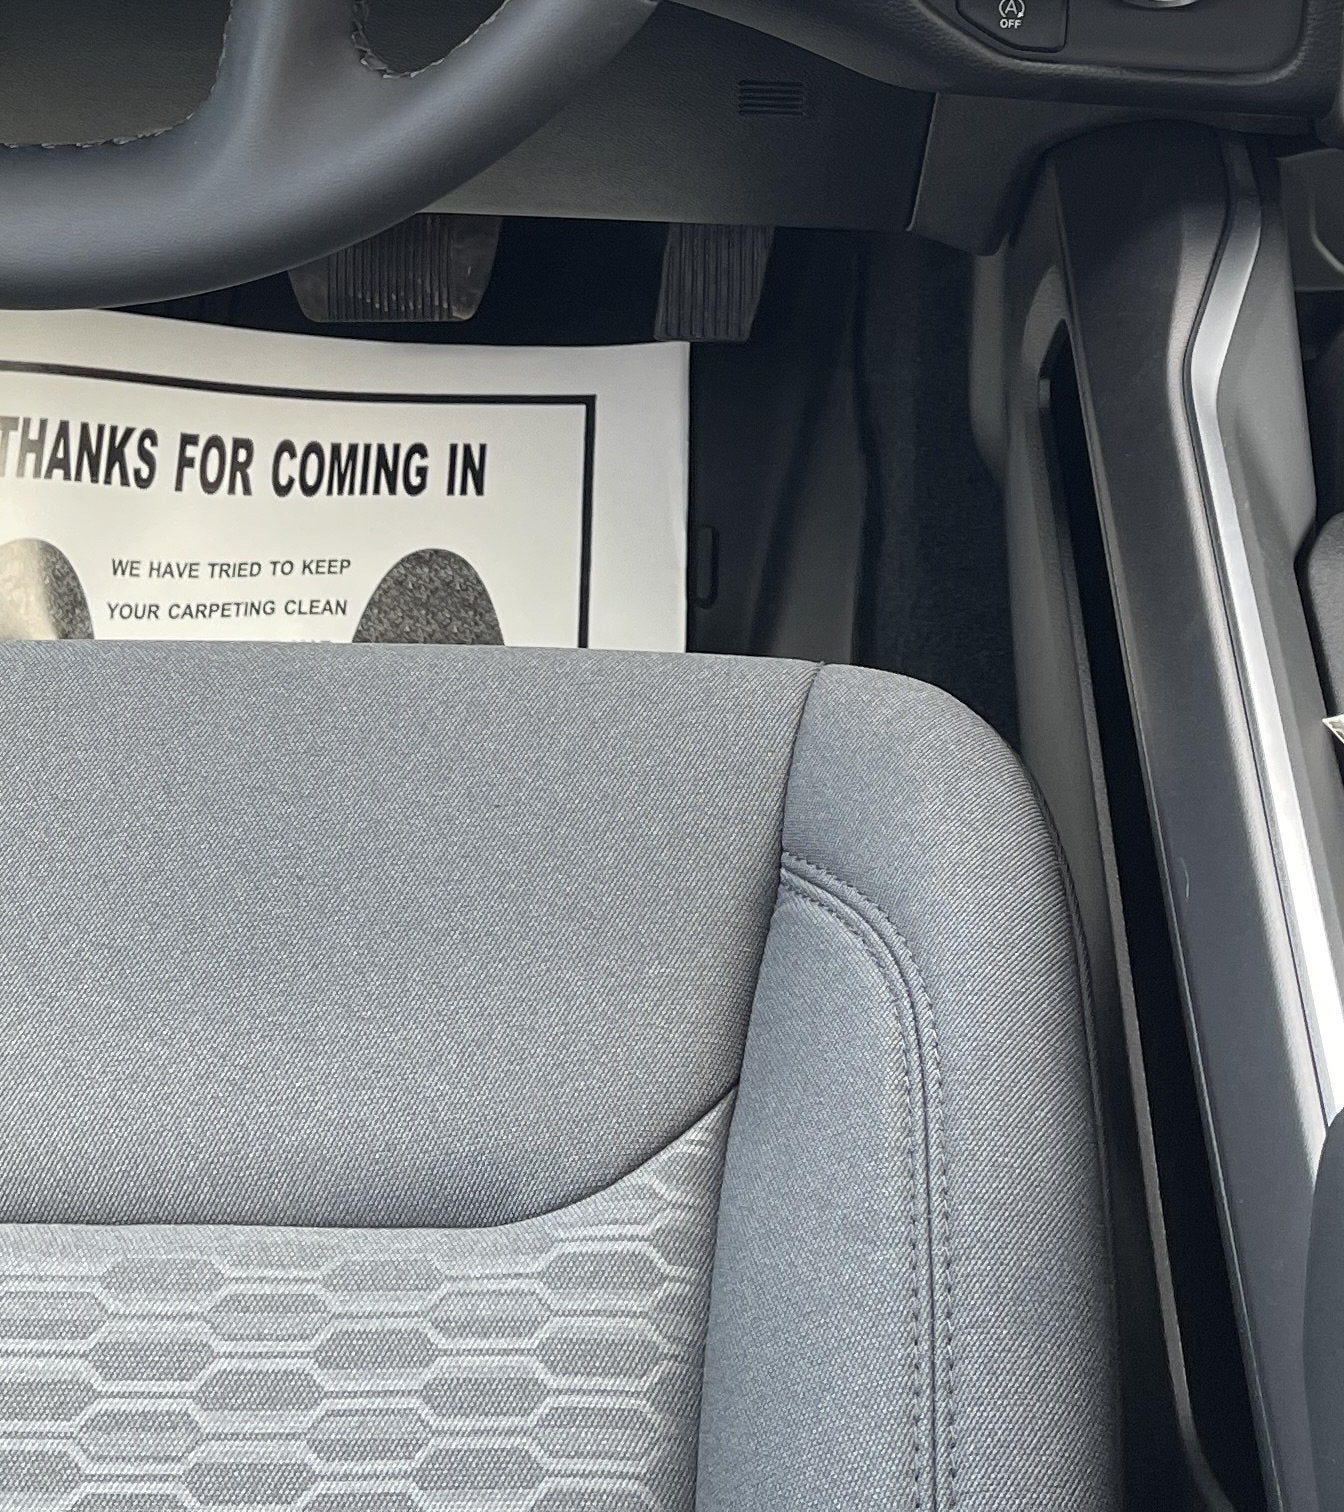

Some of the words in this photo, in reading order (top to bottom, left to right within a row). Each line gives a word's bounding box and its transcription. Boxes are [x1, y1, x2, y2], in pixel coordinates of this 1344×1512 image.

[1000, 17, 1022, 29] OFF
[174, 432, 254, 496] FOR
[272, 439, 430, 498] COMING
[446, 442, 488, 497] IN
[111, 558, 141, 577] WE
[148, 561, 200, 579] HAVE
[207, 561, 262, 579] TRIED
[270, 560, 294, 576] TO
[302, 559, 351, 576] KEEP
[107, 602, 160, 620] YOUR
[168, 599, 276, 619] CARPETING
[284, 599, 348, 617] CLEAN
